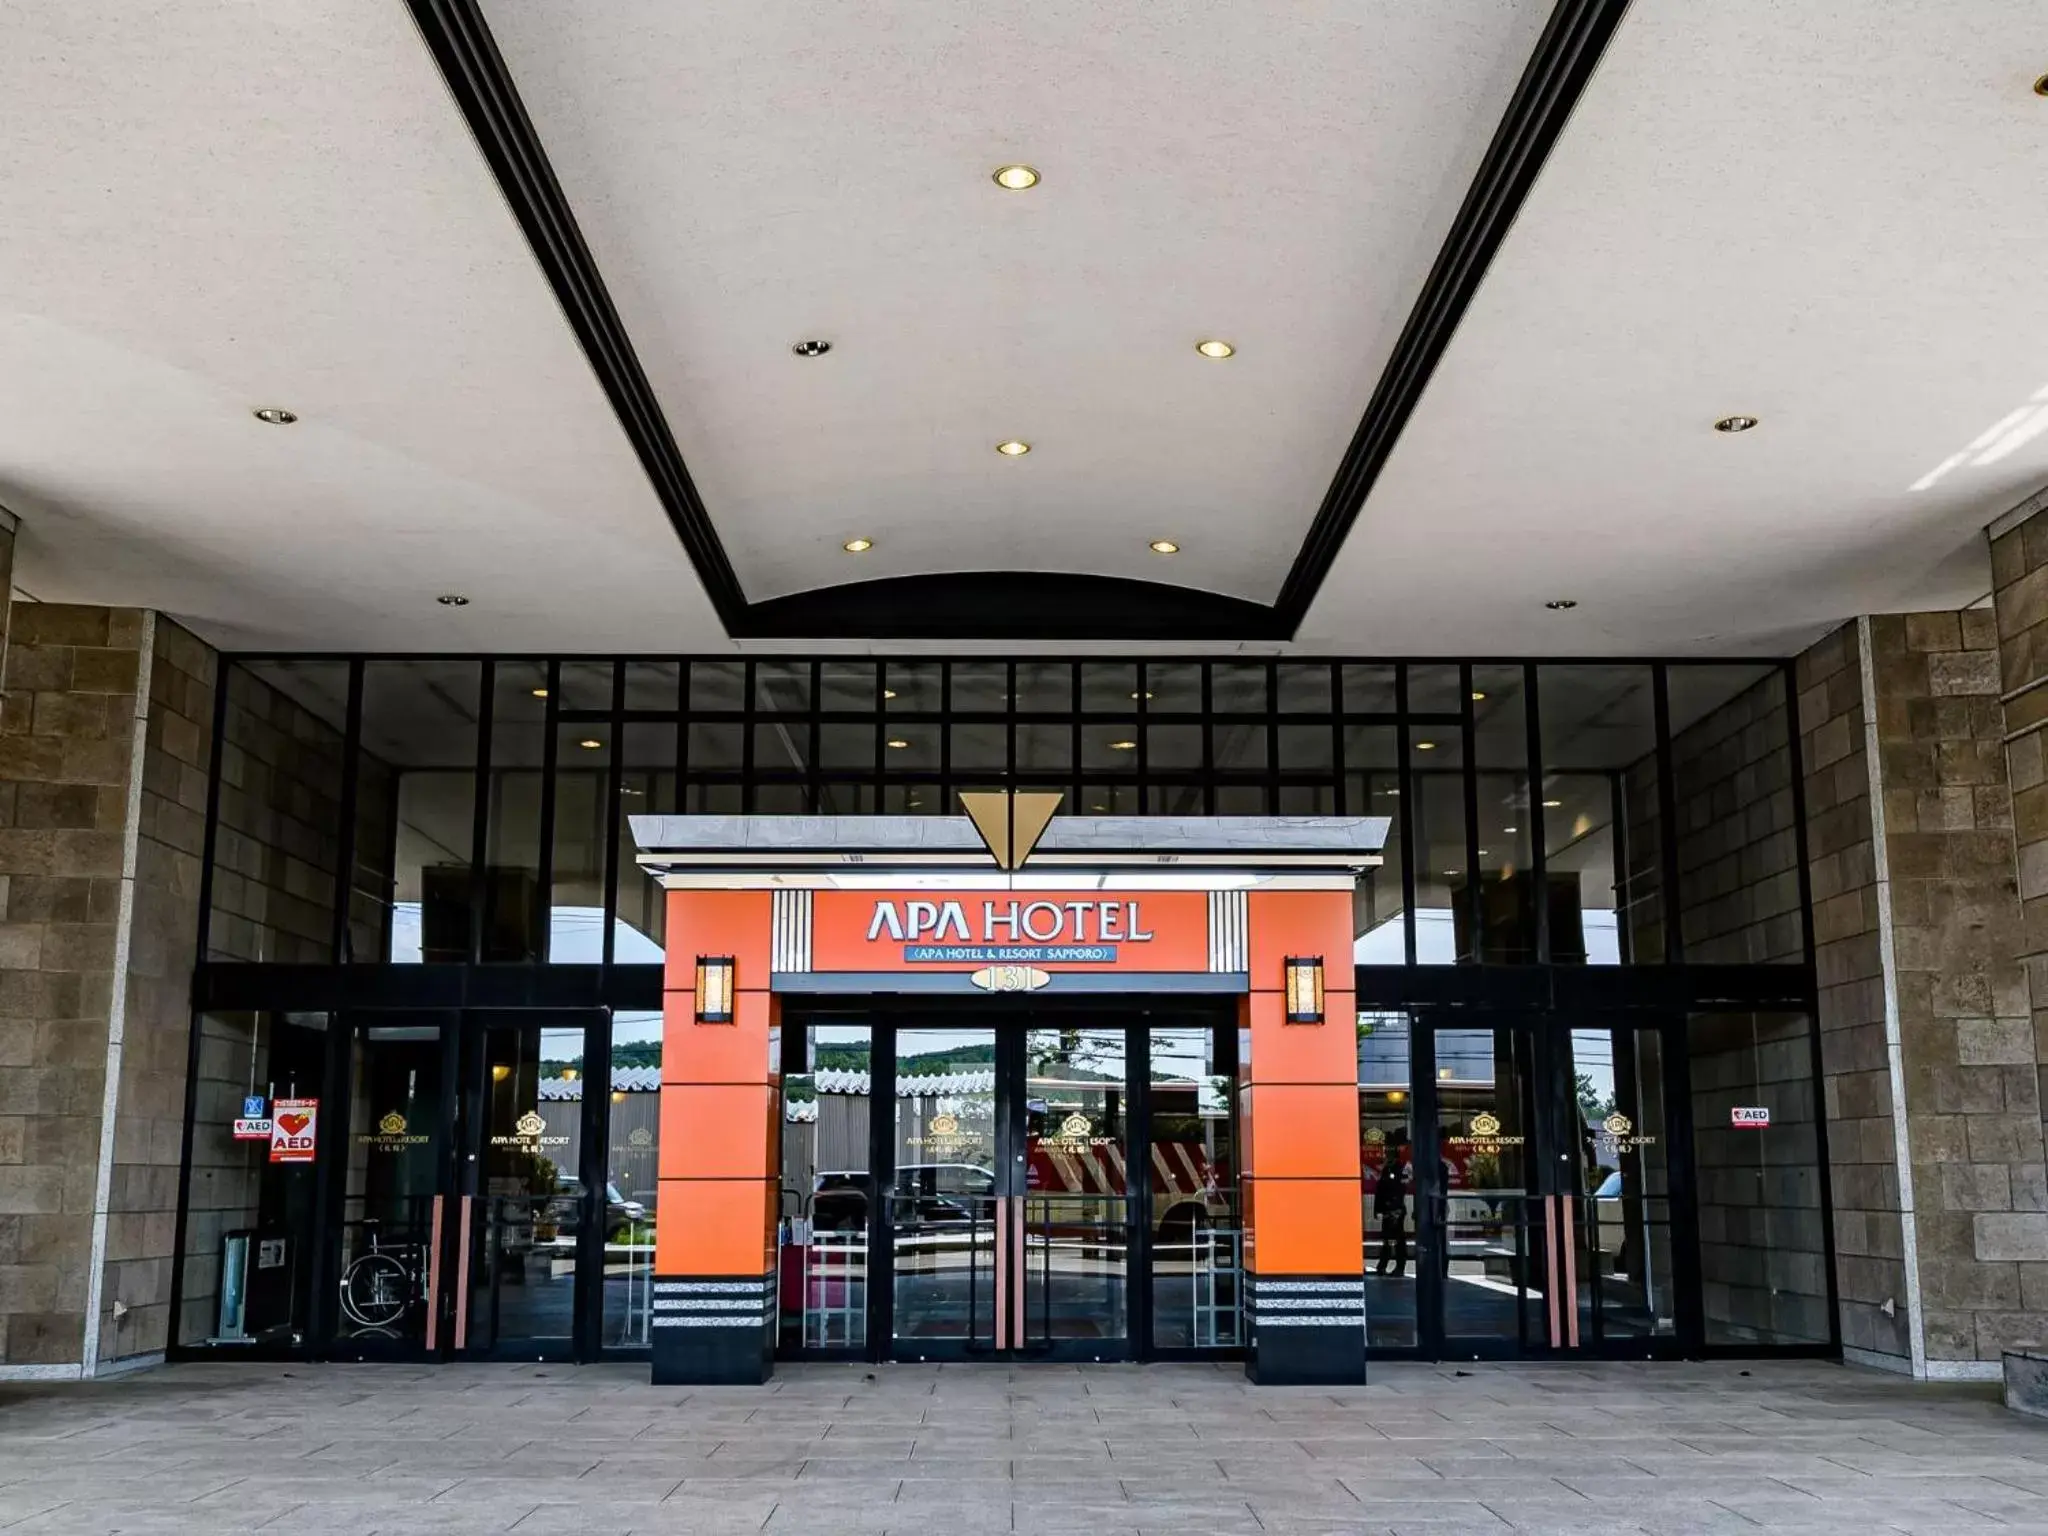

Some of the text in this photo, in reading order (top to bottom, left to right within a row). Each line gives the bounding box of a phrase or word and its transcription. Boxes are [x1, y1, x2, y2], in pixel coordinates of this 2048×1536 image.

[866, 900, 1154, 942] APA HOTEL
[946, 947, 984, 960] HOTEL
[985, 948, 996, 960] &
[998, 947, 1042, 960] RESORT
[986, 965, 1034, 992] 131
[1744, 1110, 1767, 1119] AED
[246, 1121, 270, 1131] AED
[273, 1136, 313, 1150] AED
[1449, 1136, 1465, 1145] APA
[1466, 1136, 1490, 1145] HOTEL
[1496, 1136, 1524, 1145] RESORT
